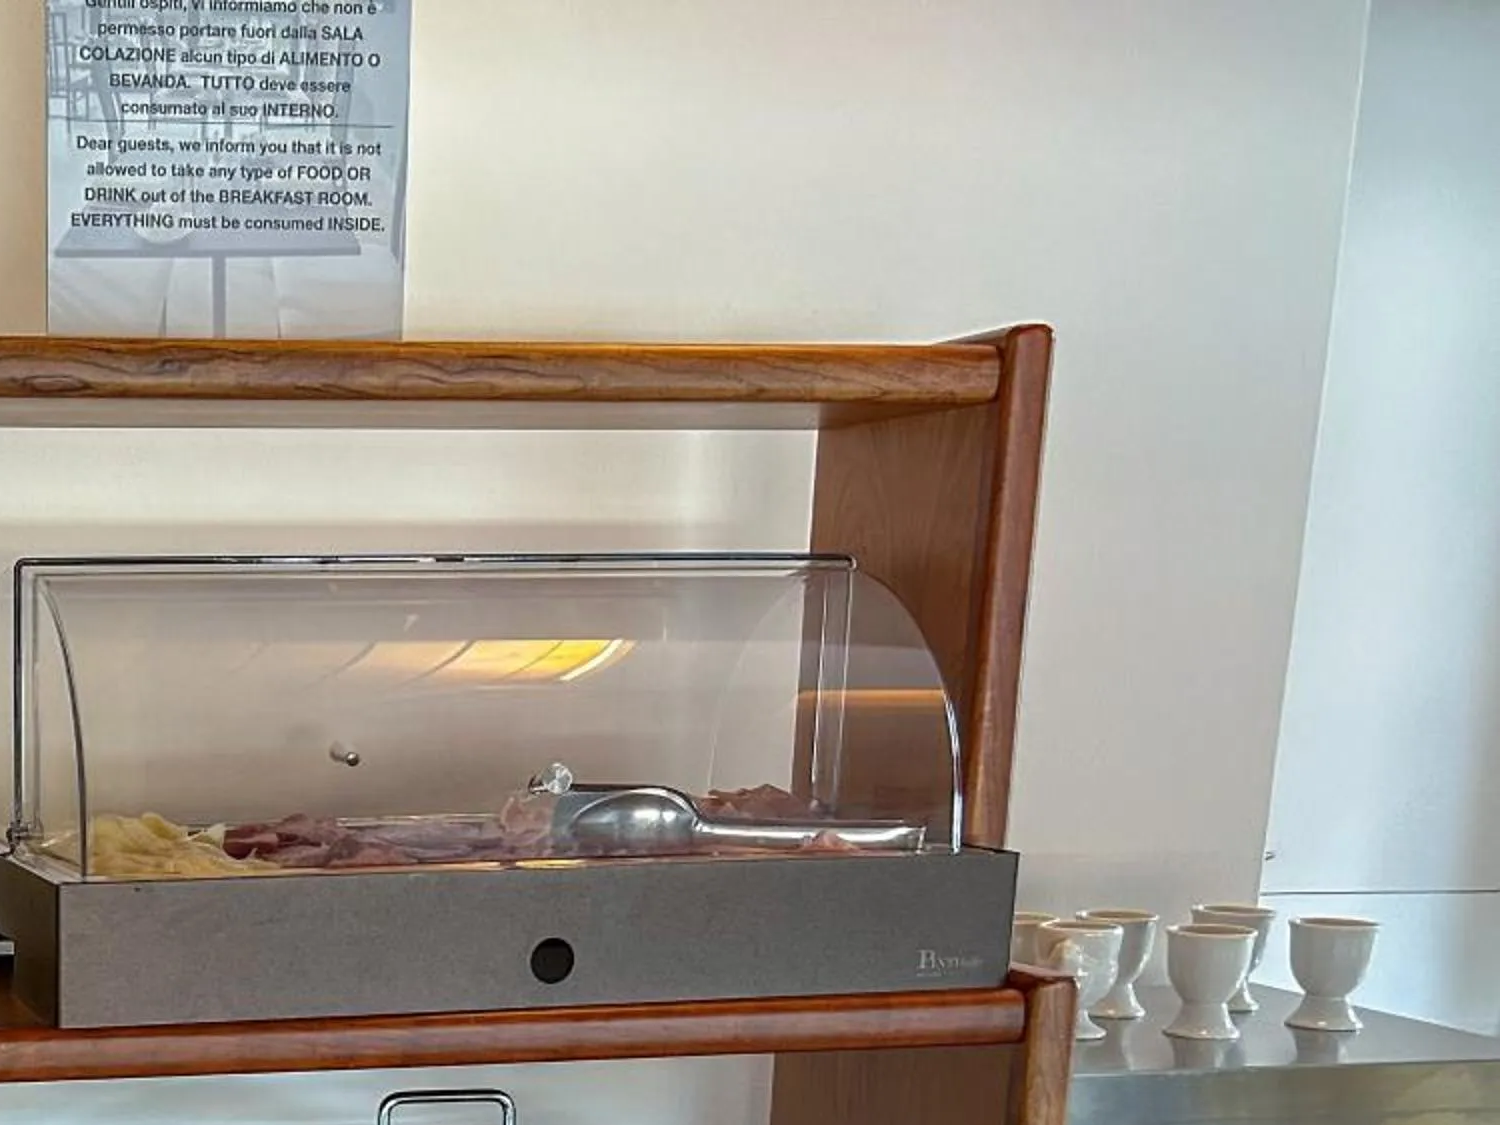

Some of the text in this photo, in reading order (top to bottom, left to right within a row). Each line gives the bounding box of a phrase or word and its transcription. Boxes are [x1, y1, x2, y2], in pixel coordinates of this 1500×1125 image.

[209, 0, 297, 13] informiamo
[301, 0, 330, 14] che
[333, 3, 363, 15] non
[97, 23, 364, 41] permesso portare fuori dalla SALA
[79, 46, 381, 67] COLAZIONE alcun tipo di ALIMENTO O
[109, 73, 352, 92] BEVANDA. TUTTO deve essere
[121, 102, 339, 118] consumato al suo INTERNO.
[76, 135, 381, 156] Dear guests, we inform you that it is not
[87, 162, 371, 182] allowed to take any type of FOOD OR
[85, 187, 373, 207] DRINK out of the BREAKFAST ROOM.
[71, 212, 385, 232] EVERYTHING must be consumed INSIDE.
